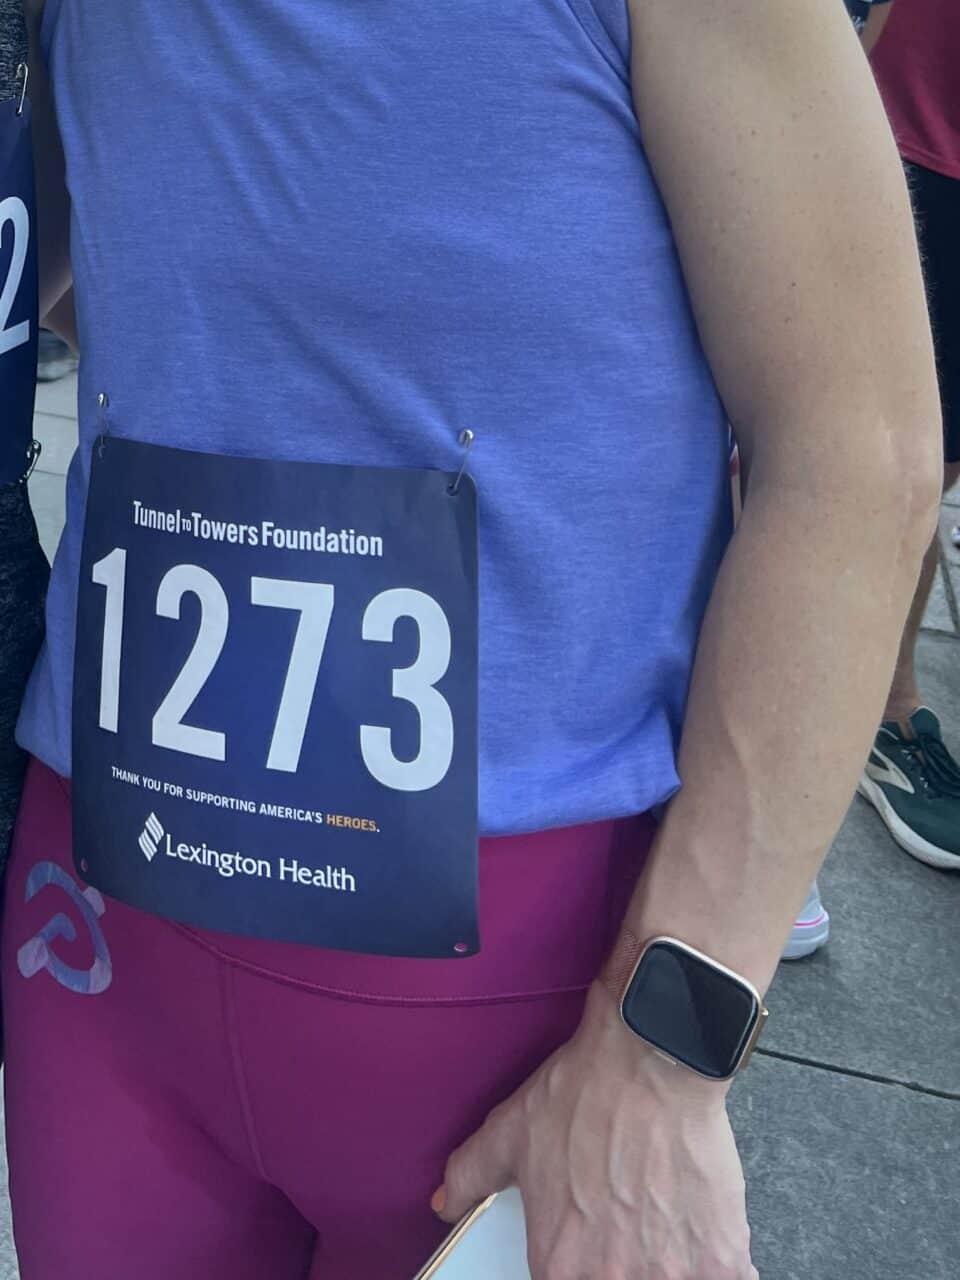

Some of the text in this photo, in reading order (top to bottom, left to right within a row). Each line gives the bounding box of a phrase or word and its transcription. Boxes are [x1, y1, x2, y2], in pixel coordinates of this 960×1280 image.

[133, 500, 180, 534] Tunnel
[191, 512, 258, 546] Towers
[262, 521, 383, 557] Foundation
[92, 547, 454, 792] 1273
[111, 766, 380, 833] THANK YOU FOR SUPPORTING AMERICA'S HEROES.
[166, 833, 356, 892] Lexington Health
